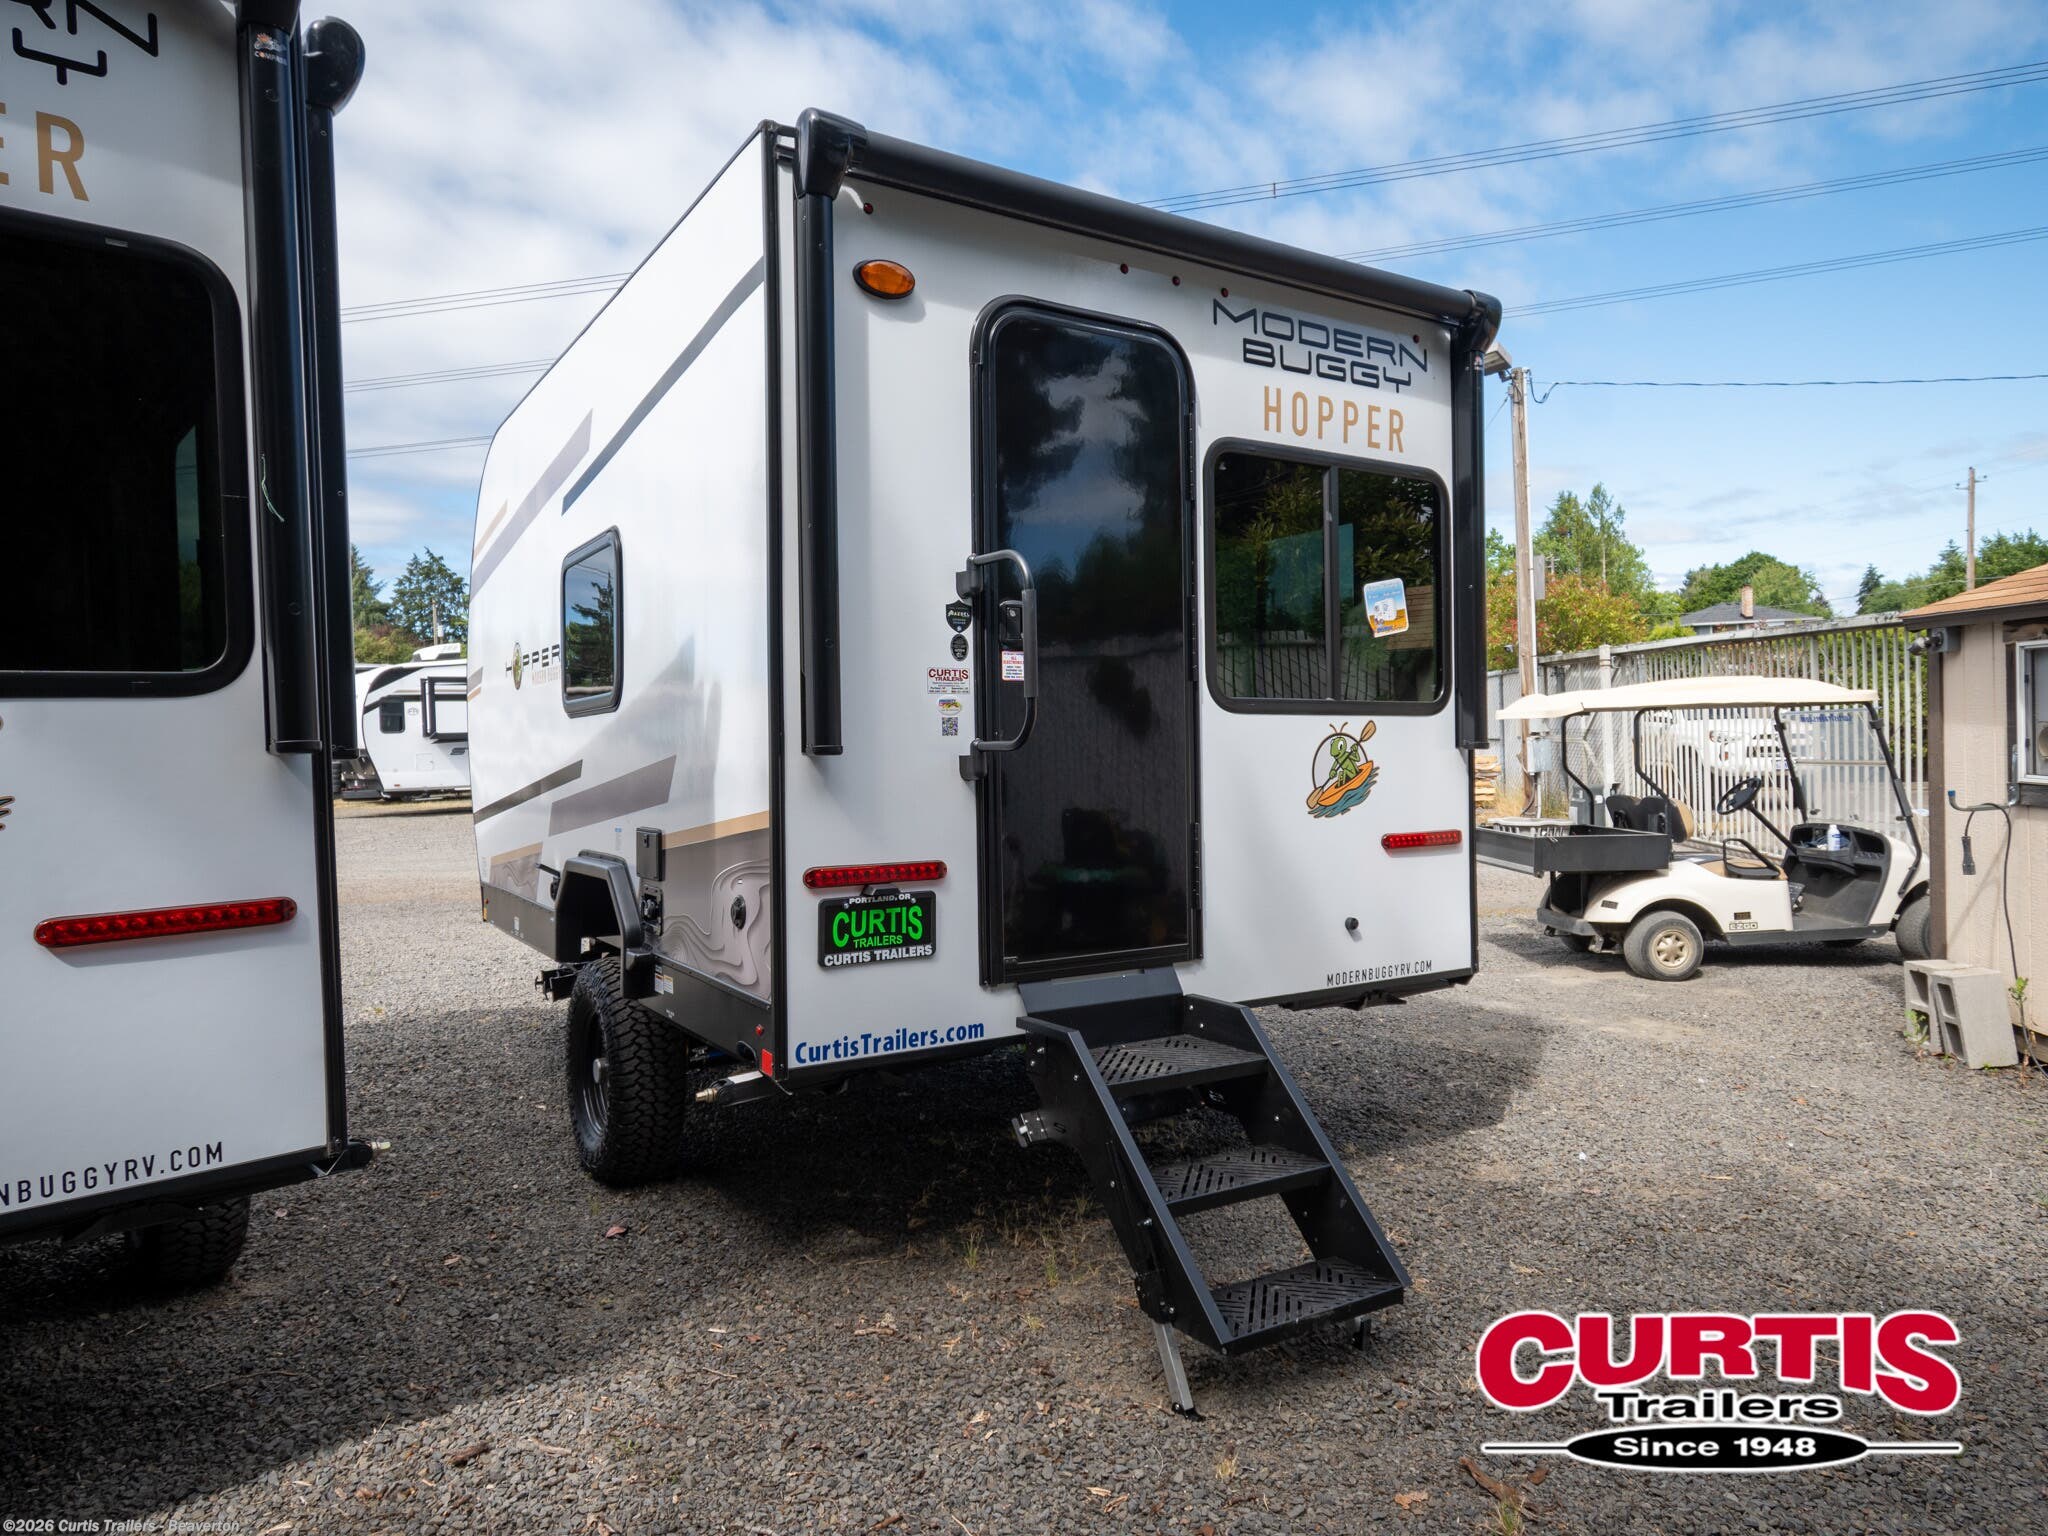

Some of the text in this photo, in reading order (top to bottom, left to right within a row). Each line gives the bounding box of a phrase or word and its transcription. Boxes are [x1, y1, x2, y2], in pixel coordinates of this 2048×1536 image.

[0, 103, 90, 202] R
[1213, 298, 1428, 373] MODERN
[1242, 337, 1412, 394] BUGGY
[1263, 385, 1405, 453] HOPPER
[928, 668, 969, 680] CURTIS
[898, 893, 911, 901] OR
[832, 905, 923, 948] CURTIS
[853, 935, 903, 949] TRAILERS
[824, 944, 933, 967] CURTIS TRAILERS
[1326, 960, 1432, 986] MODERNBUGGYRV.COM
[795, 1022, 985, 1064] CurtisTrailers.com
